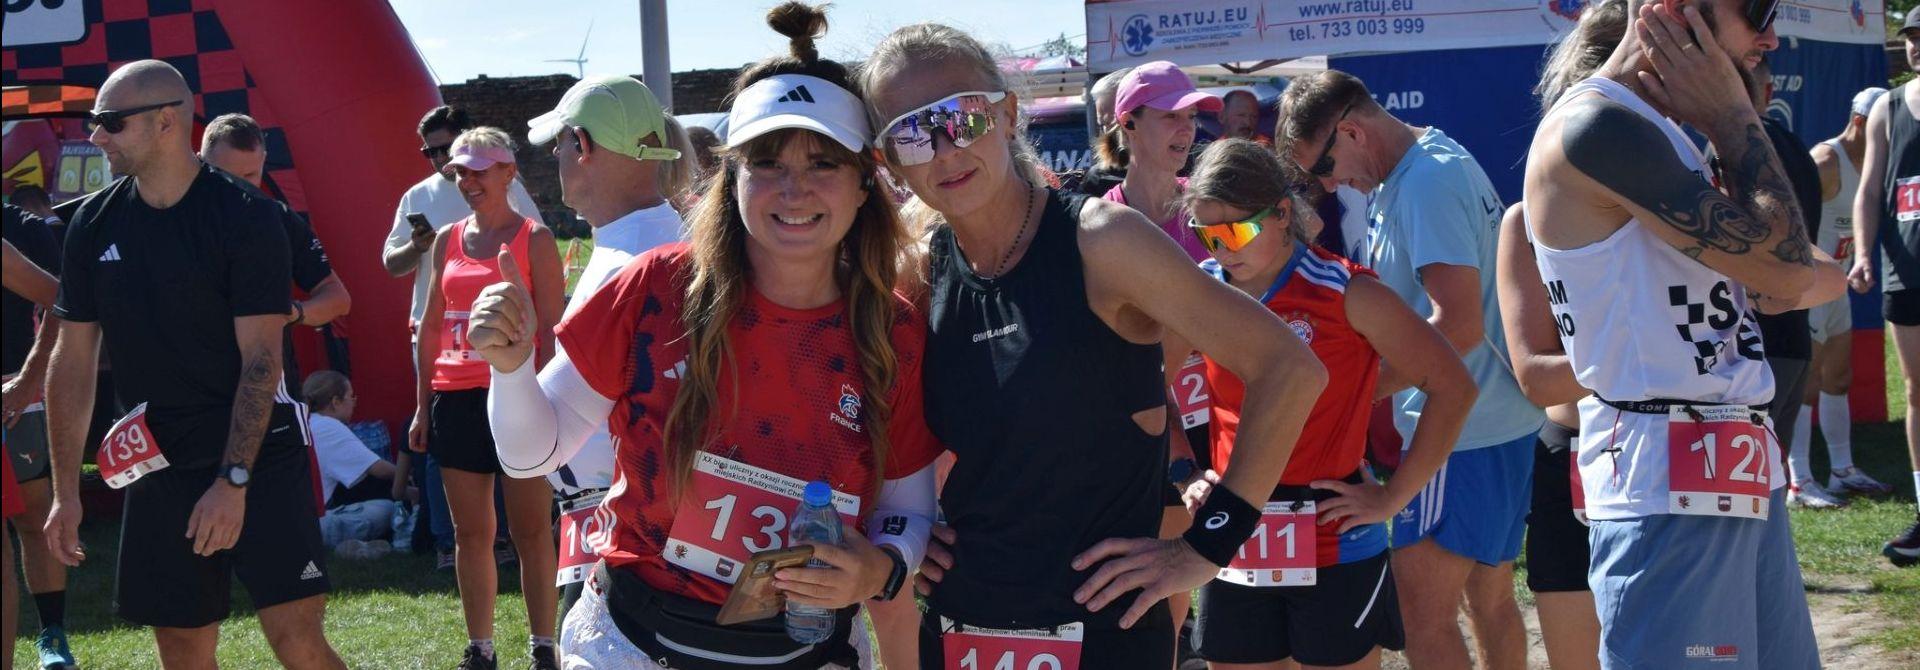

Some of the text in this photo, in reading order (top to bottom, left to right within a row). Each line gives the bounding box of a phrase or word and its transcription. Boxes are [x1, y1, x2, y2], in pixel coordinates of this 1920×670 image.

[1159, 7, 1248, 28] RATUJ.EU
[1289, 18, 1425, 41] tel. 733 003 999
[1385, 91, 1424, 110] AID
[1690, 433, 1768, 485] 122
[714, 468, 747, 482] miejskich
[729, 464, 754, 477] uliczny
[760, 473, 781, 486] okazji
[704, 494, 787, 553] 13
